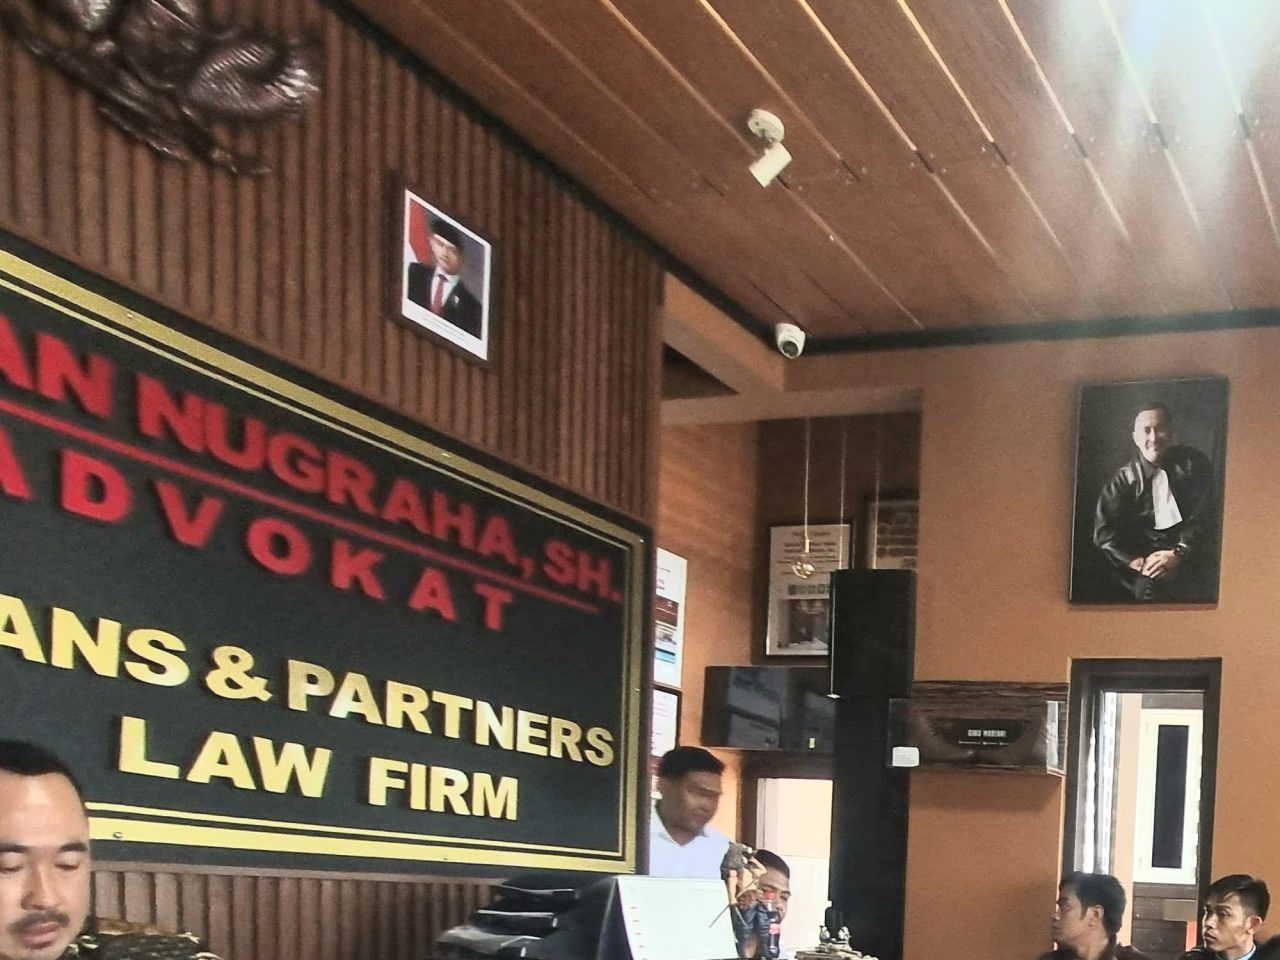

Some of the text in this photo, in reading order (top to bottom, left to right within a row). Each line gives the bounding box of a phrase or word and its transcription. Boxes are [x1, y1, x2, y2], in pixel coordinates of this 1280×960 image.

[136, 373, 535, 578] NUGRAHA,
[543, 540, 625, 604] SH.
[0, 593, 190, 687] ANS
[205, 645, 273, 702] &
[287, 659, 615, 767] PARTNERS
[118, 715, 519, 821] LAW FIRM
